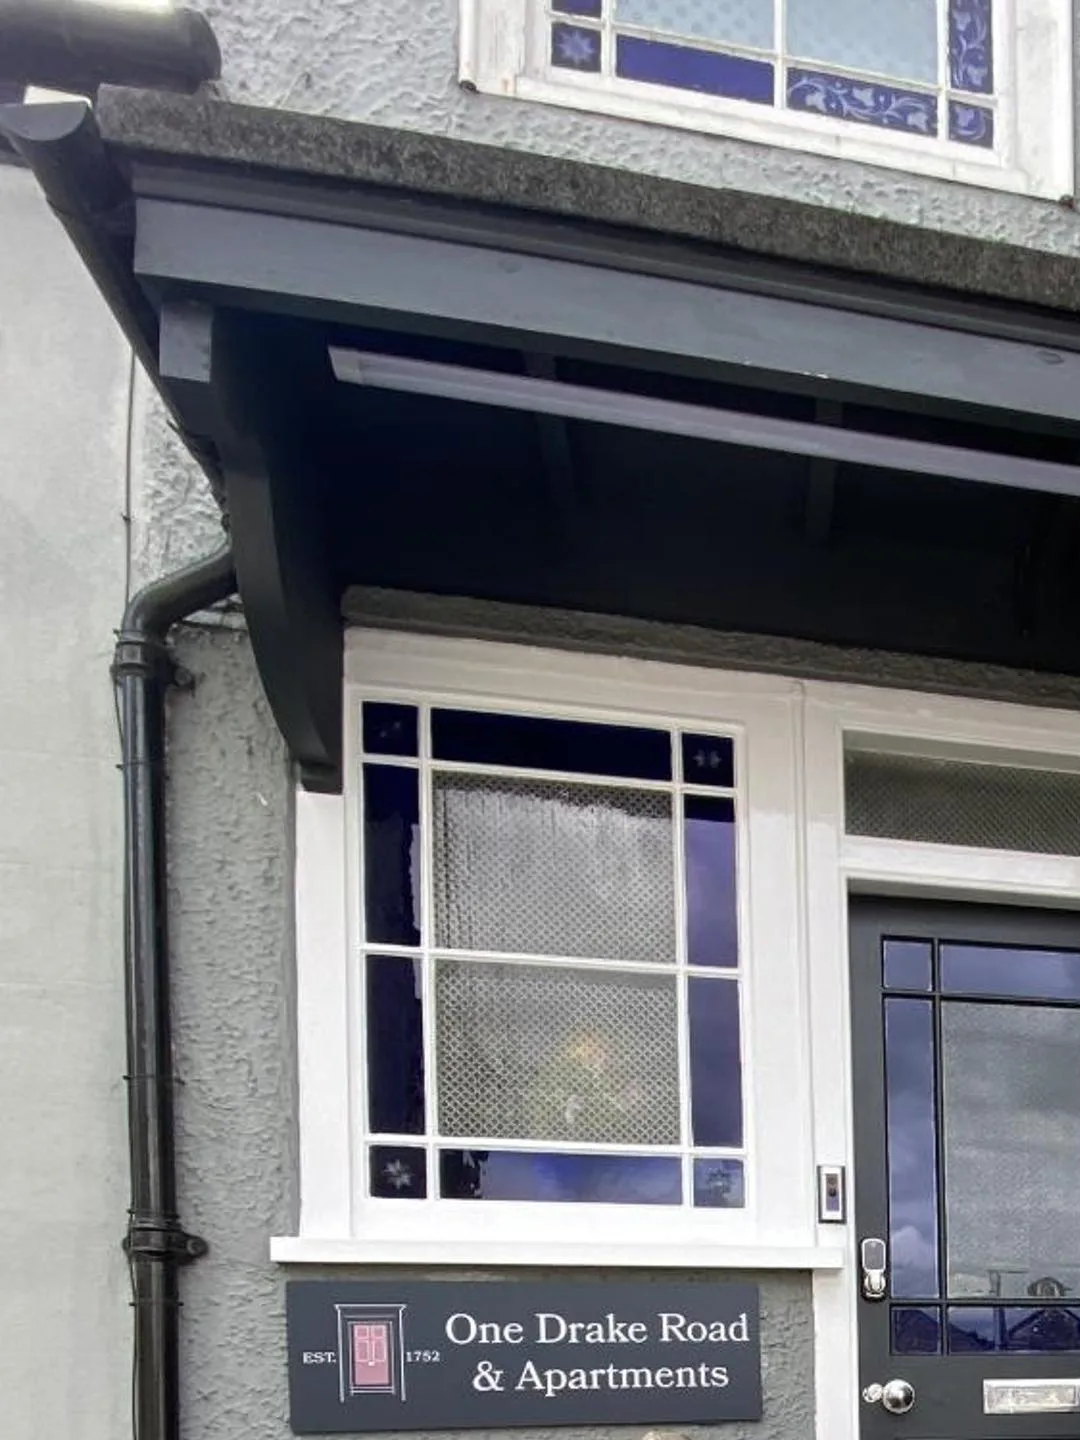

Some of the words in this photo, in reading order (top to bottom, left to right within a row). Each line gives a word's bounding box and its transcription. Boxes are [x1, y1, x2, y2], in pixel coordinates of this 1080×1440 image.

[445, 1312, 524, 1345] One
[535, 1312, 648, 1344] Drake
[657, 1312, 750, 1343] Road
[302, 1351, 337, 1364] EST.
[405, 1349, 441, 1363] 1752
[472, 1360, 505, 1392] &
[514, 1359, 730, 1398] Apartments
